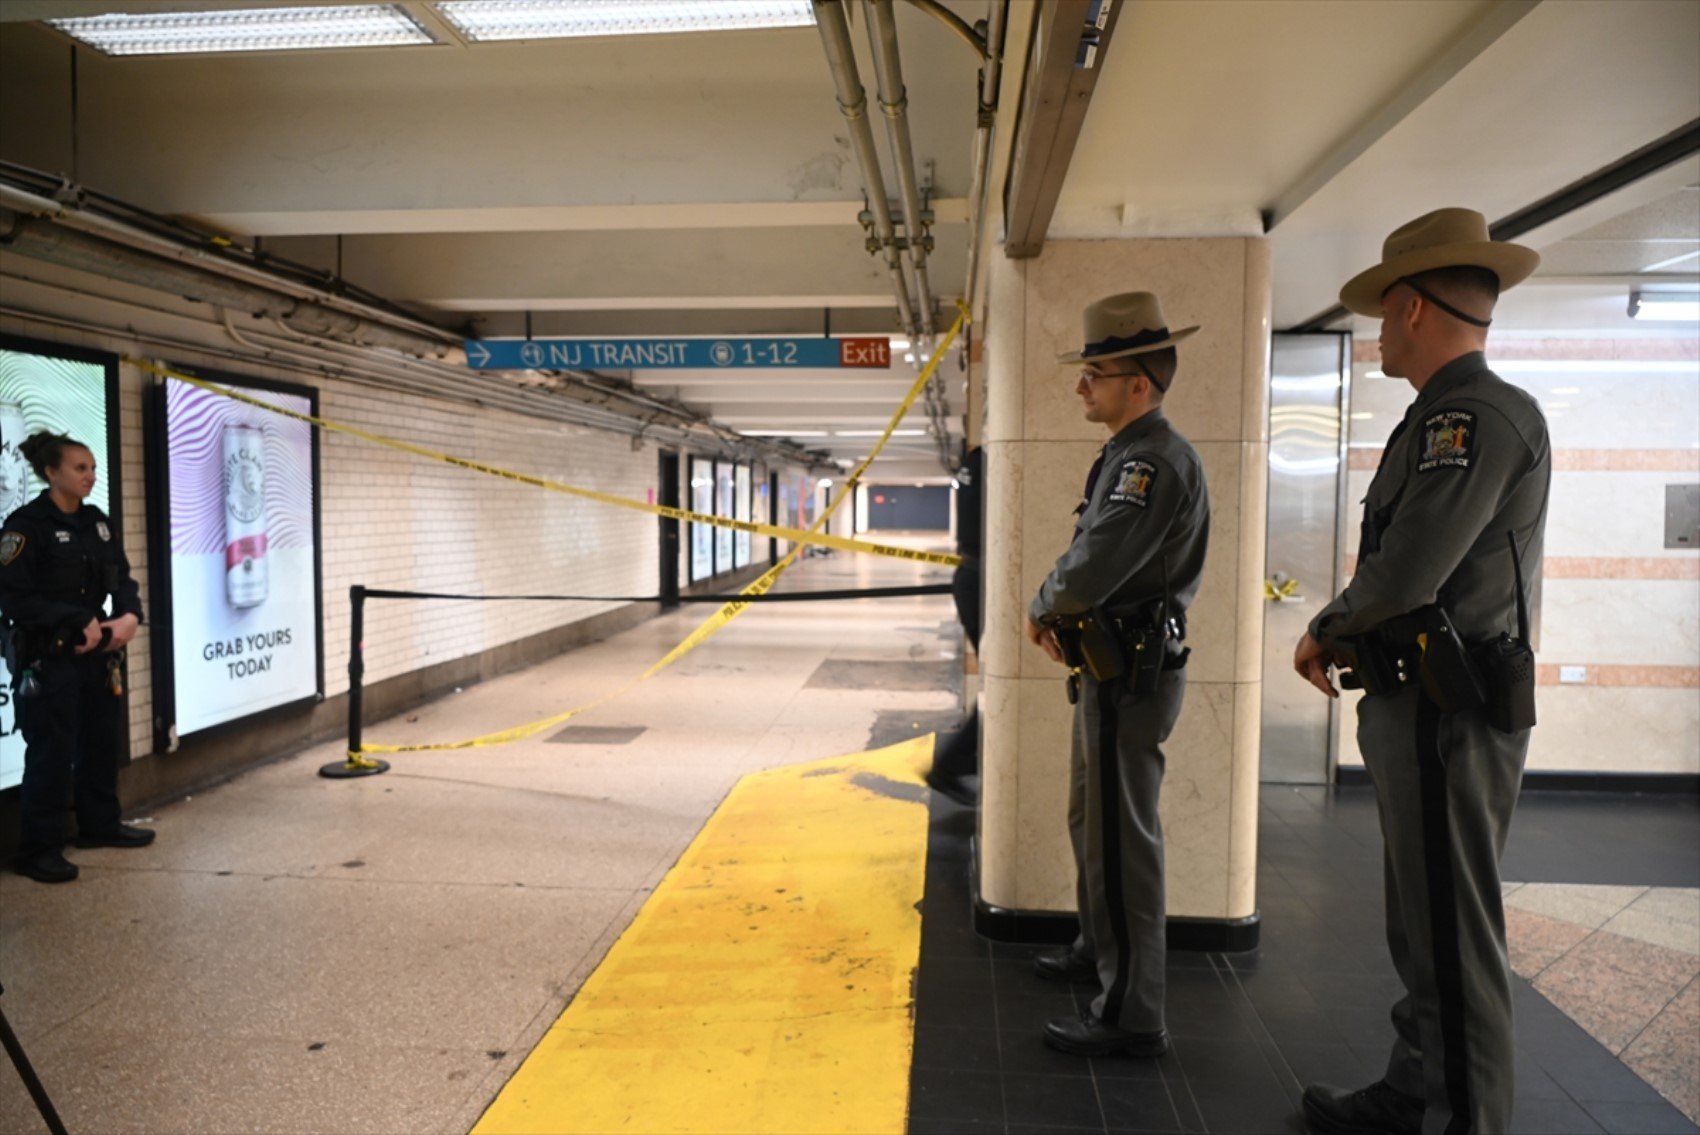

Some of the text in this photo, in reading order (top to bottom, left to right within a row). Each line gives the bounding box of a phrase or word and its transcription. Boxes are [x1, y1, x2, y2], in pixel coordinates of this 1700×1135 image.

[550, 341, 887, 365] NJ TRANSIT 1-12 Exit
[1426, 411, 1473, 426] NEW YORK
[1440, 457, 1470, 467] POLICE
[873, 545, 897, 556] POLICE
[929, 553, 943, 563] NOT
[203, 627, 292, 661] GRAB YOURS
[227, 653, 273, 680] TODAY
